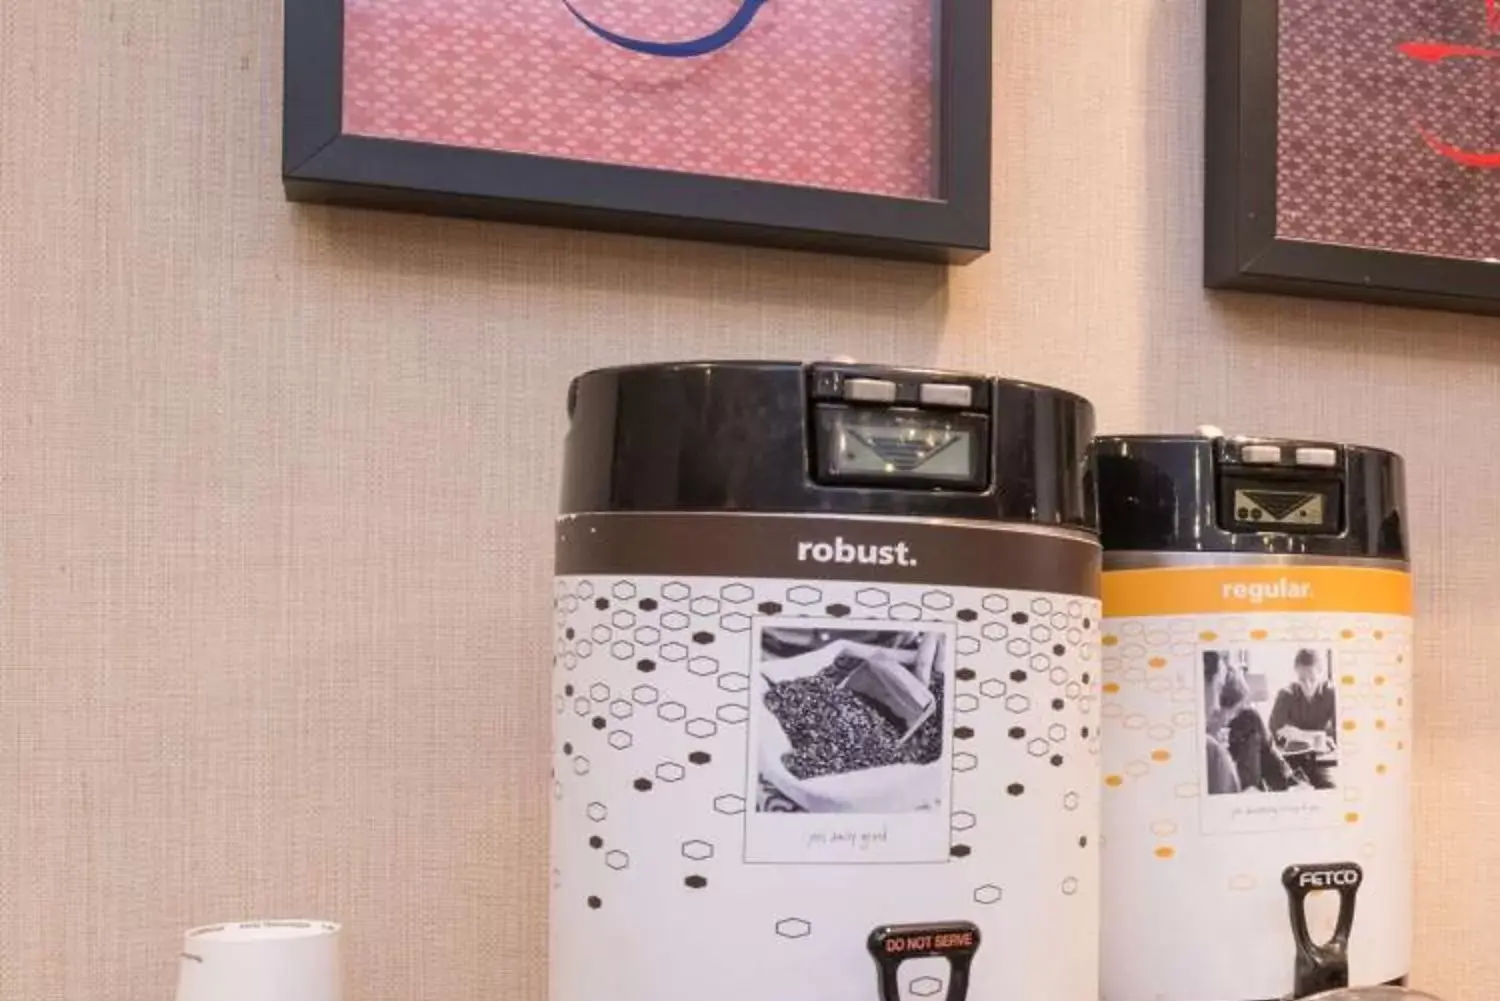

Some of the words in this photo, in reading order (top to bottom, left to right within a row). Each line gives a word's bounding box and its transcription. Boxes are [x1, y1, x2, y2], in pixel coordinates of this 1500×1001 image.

[797, 536, 918, 567] robust.
[1222, 576, 1315, 605] regular.
[1299, 869, 1358, 887] FETCO
[886, 937, 905, 953] DO
[907, 935, 933, 950] NOT
[934, 931, 974, 948] SERVE
